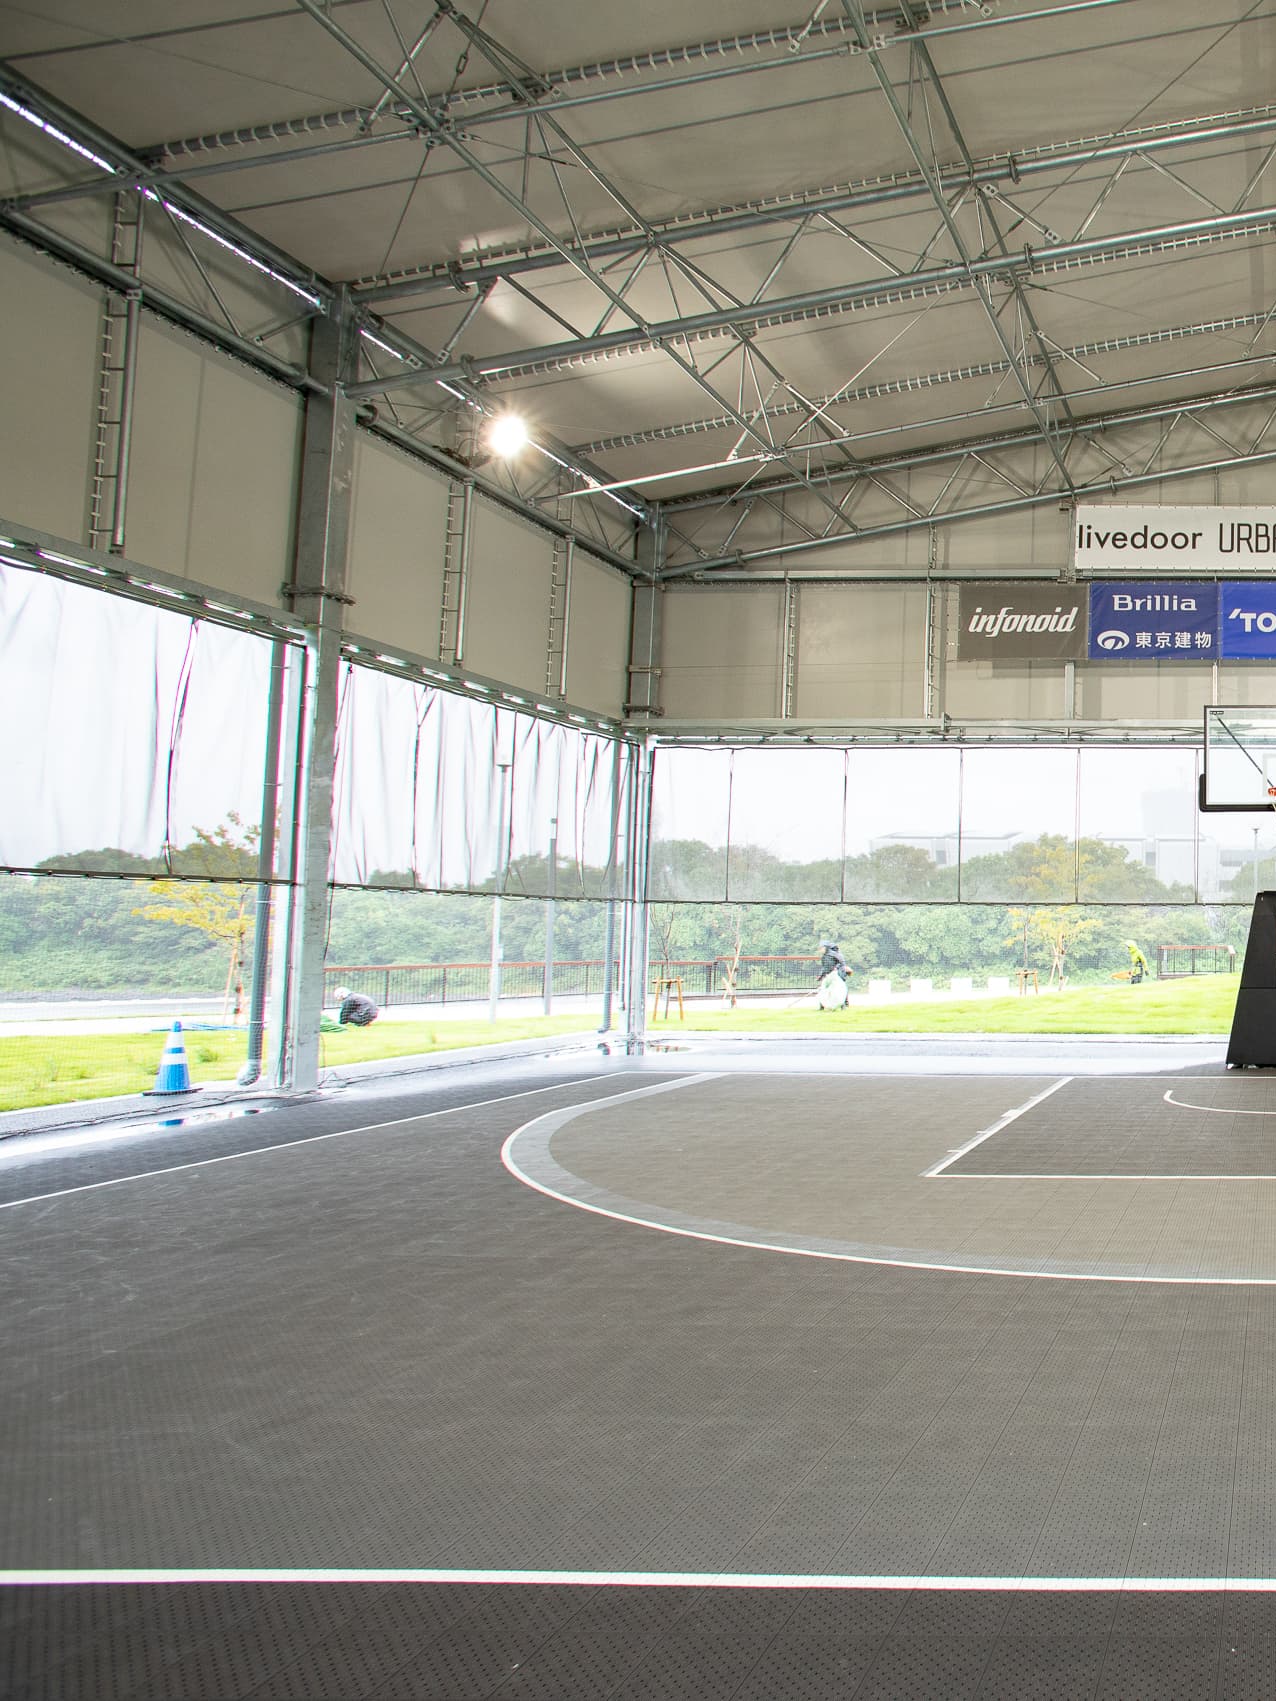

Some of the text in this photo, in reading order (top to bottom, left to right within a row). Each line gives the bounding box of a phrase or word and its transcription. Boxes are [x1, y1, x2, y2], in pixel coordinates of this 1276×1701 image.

[1078, 525, 1204, 550] livedoor
[1112, 594, 1197, 611] Brillia
[1135, 631, 1212, 649] 東京建物
